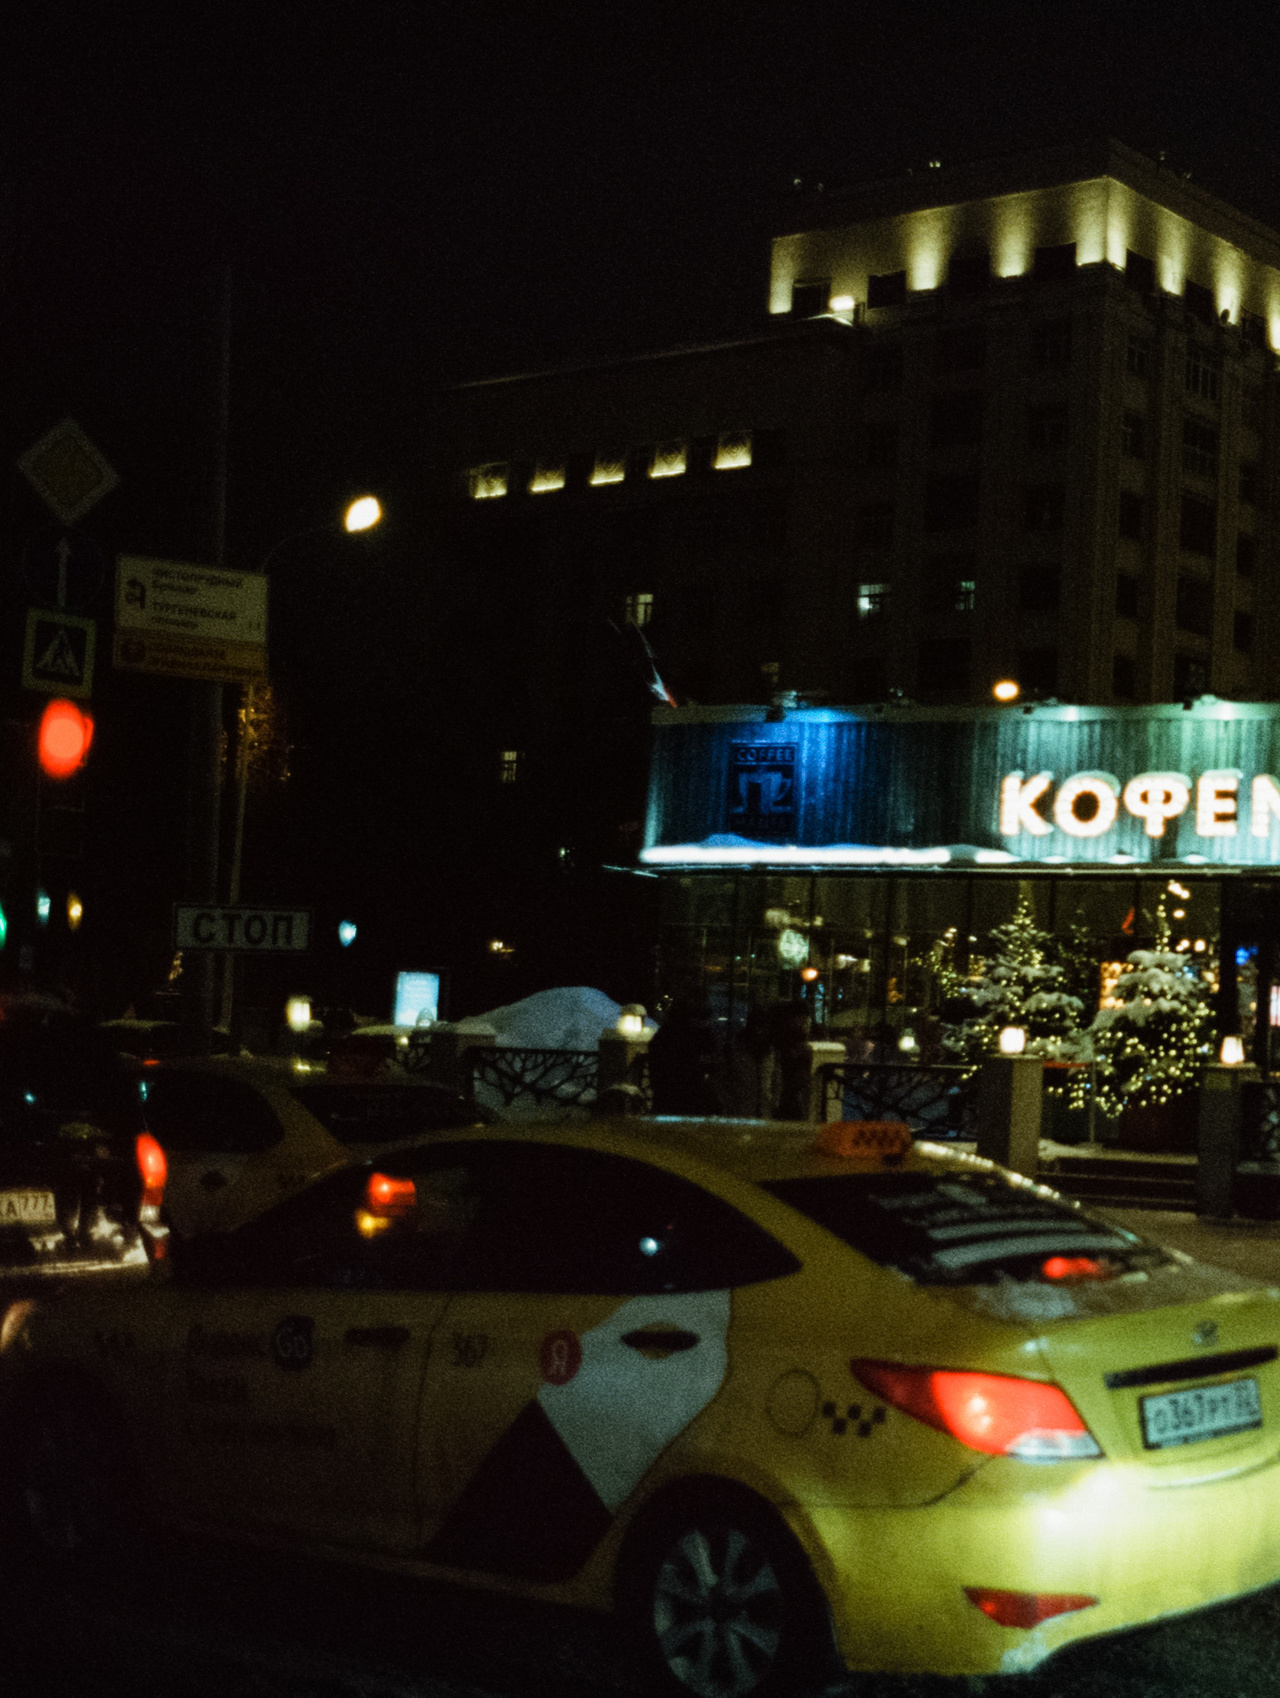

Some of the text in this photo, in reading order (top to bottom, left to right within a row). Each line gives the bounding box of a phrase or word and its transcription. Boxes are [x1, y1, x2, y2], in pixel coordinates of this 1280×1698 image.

[736, 748, 793, 762] COFFEE
[193, 912, 293, 945] СТОП
[276, 1327, 309, 1360] Go
[548, 1338, 569, 1377] Я
